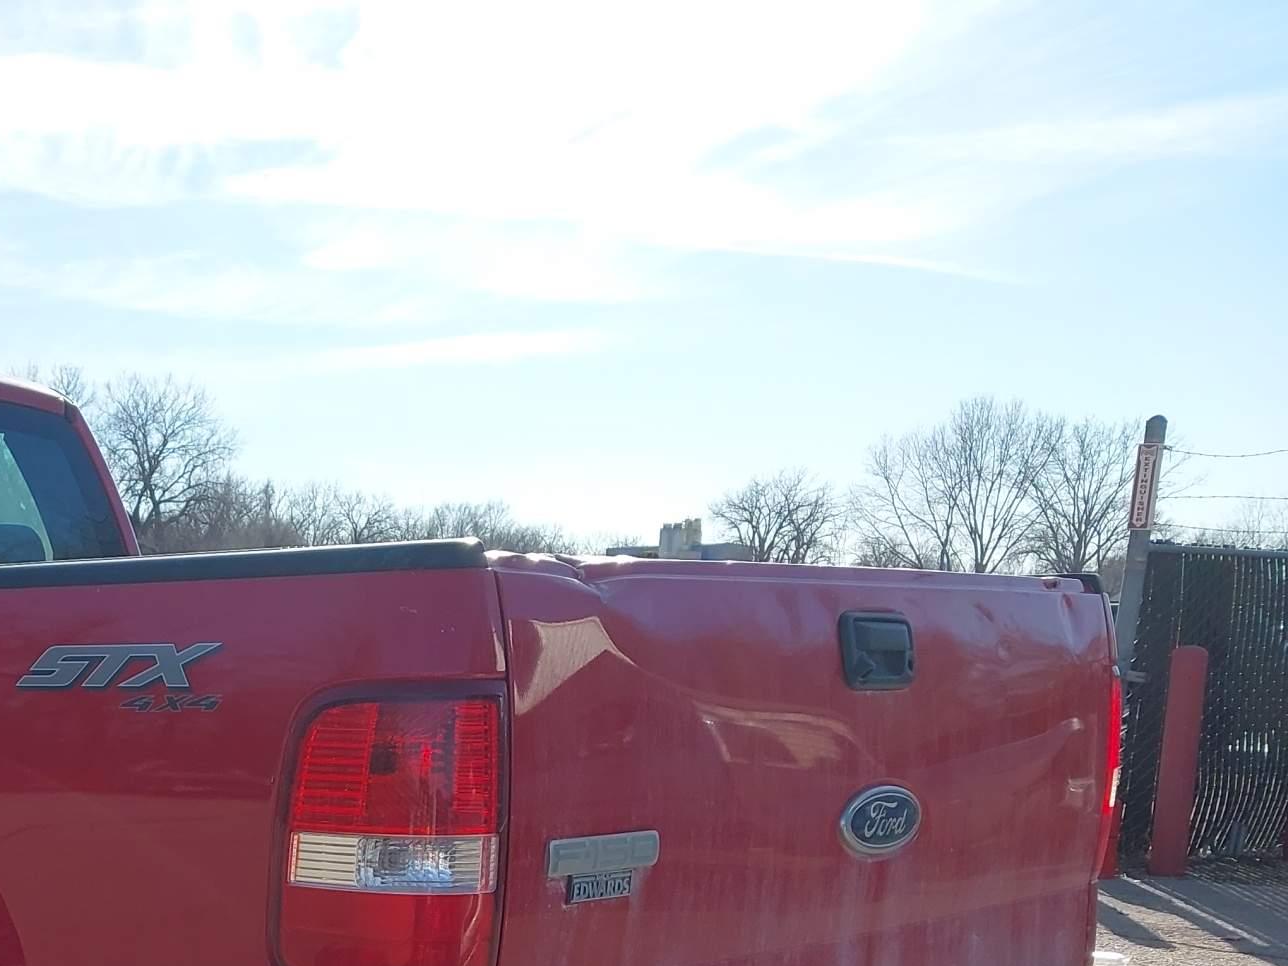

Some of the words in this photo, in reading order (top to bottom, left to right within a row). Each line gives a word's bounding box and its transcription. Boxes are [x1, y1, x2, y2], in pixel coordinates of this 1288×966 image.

[15, 642, 223, 687] STX
[864, 801, 908, 838] Ford
[573, 878, 630, 900] EDWARDS
